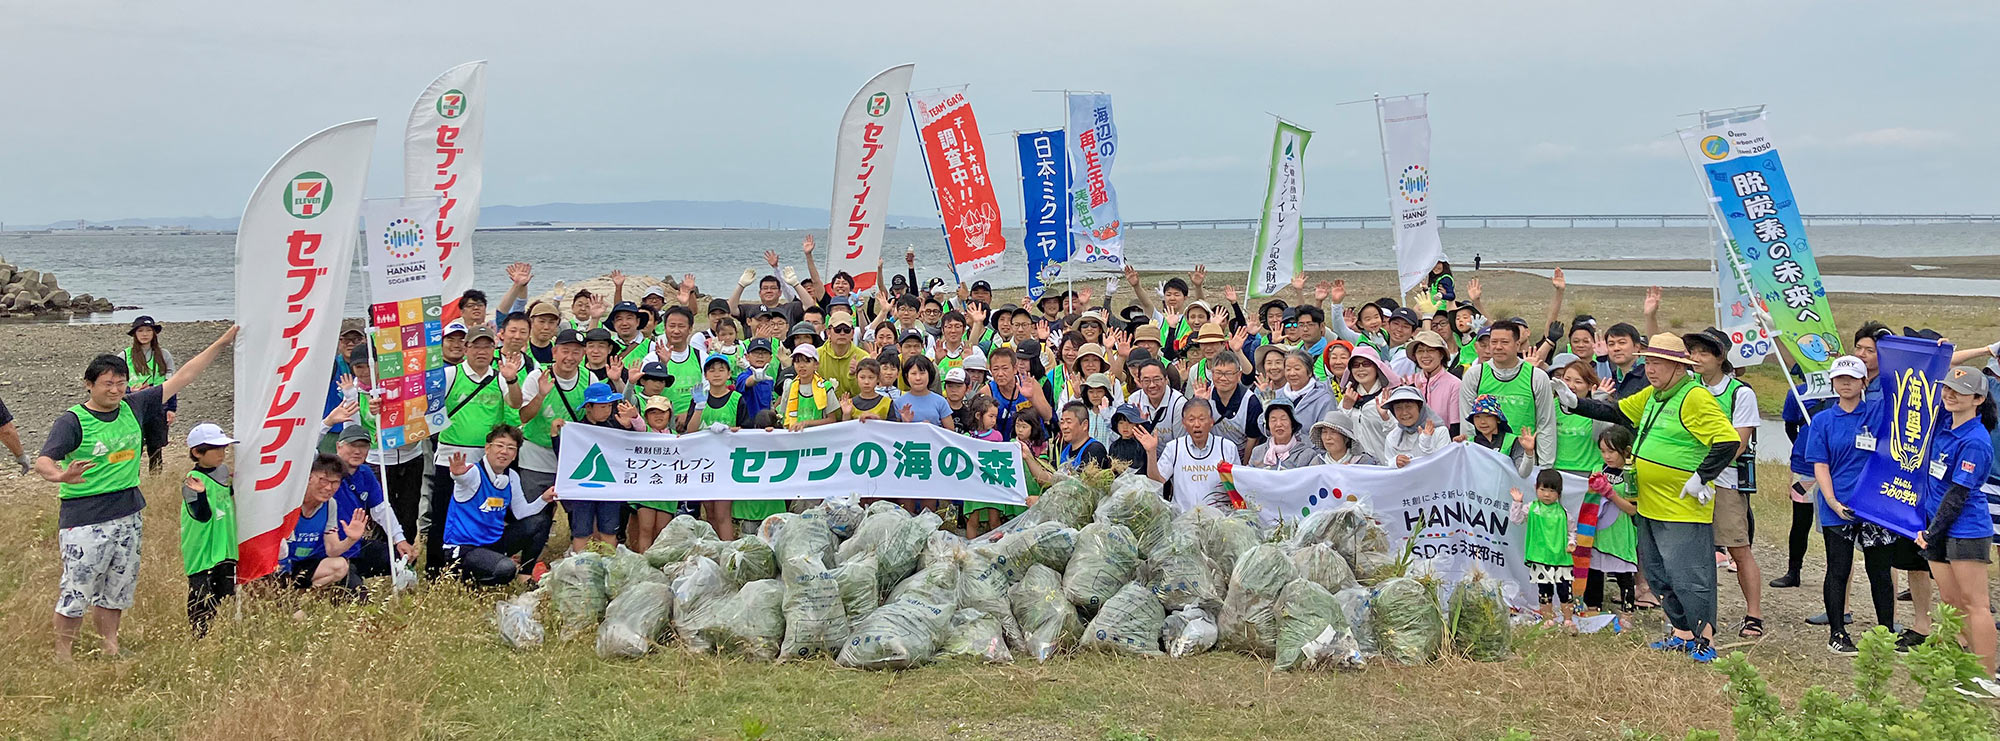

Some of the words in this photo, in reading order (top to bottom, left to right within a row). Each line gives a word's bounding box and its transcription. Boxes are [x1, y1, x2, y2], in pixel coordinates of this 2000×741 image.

[1094, 106, 1115, 157] 海辺の
[1752, 142, 1771, 153] 2050
[1034, 136, 1057, 258] 日本ミクニヤ
[1731, 171, 1821, 323] 脱炭素の未来へ
[386, 264, 426, 275] HANNAN
[1811, 372, 1831, 394] 伊
[624, 446, 680, 455] 一般財団法人
[624, 457, 716, 471] セブン-イレブン
[729, 440, 1018, 489] セブンの海の森
[1191, 474, 1209, 482] CITY
[1880, 482, 1918, 507] うみの学校
[1403, 501, 1509, 536] HANNAN
